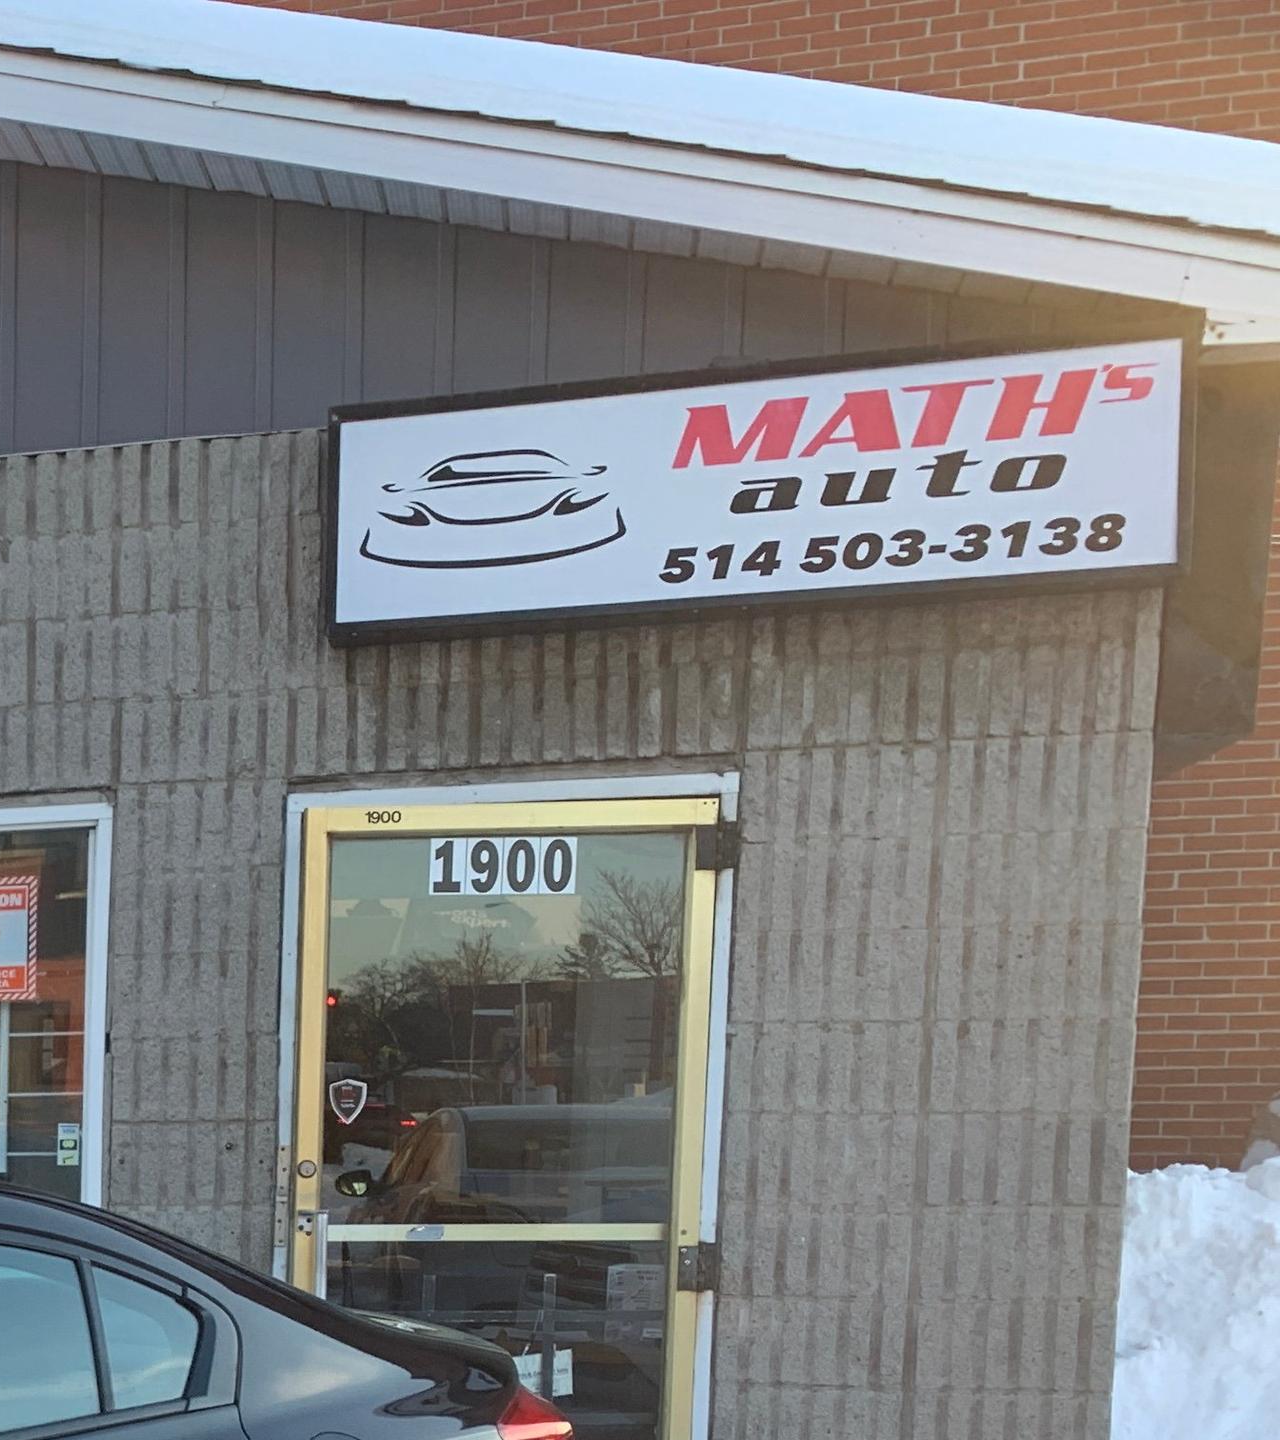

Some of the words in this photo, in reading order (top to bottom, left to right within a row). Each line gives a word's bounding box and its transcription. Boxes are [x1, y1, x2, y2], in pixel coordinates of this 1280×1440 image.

[729, 449, 1067, 514] auto
[658, 540, 782, 584] 514
[799, 513, 1127, 573] 503-3138
[364, 810, 402, 824] 1900
[433, 838, 573, 893] 1900
